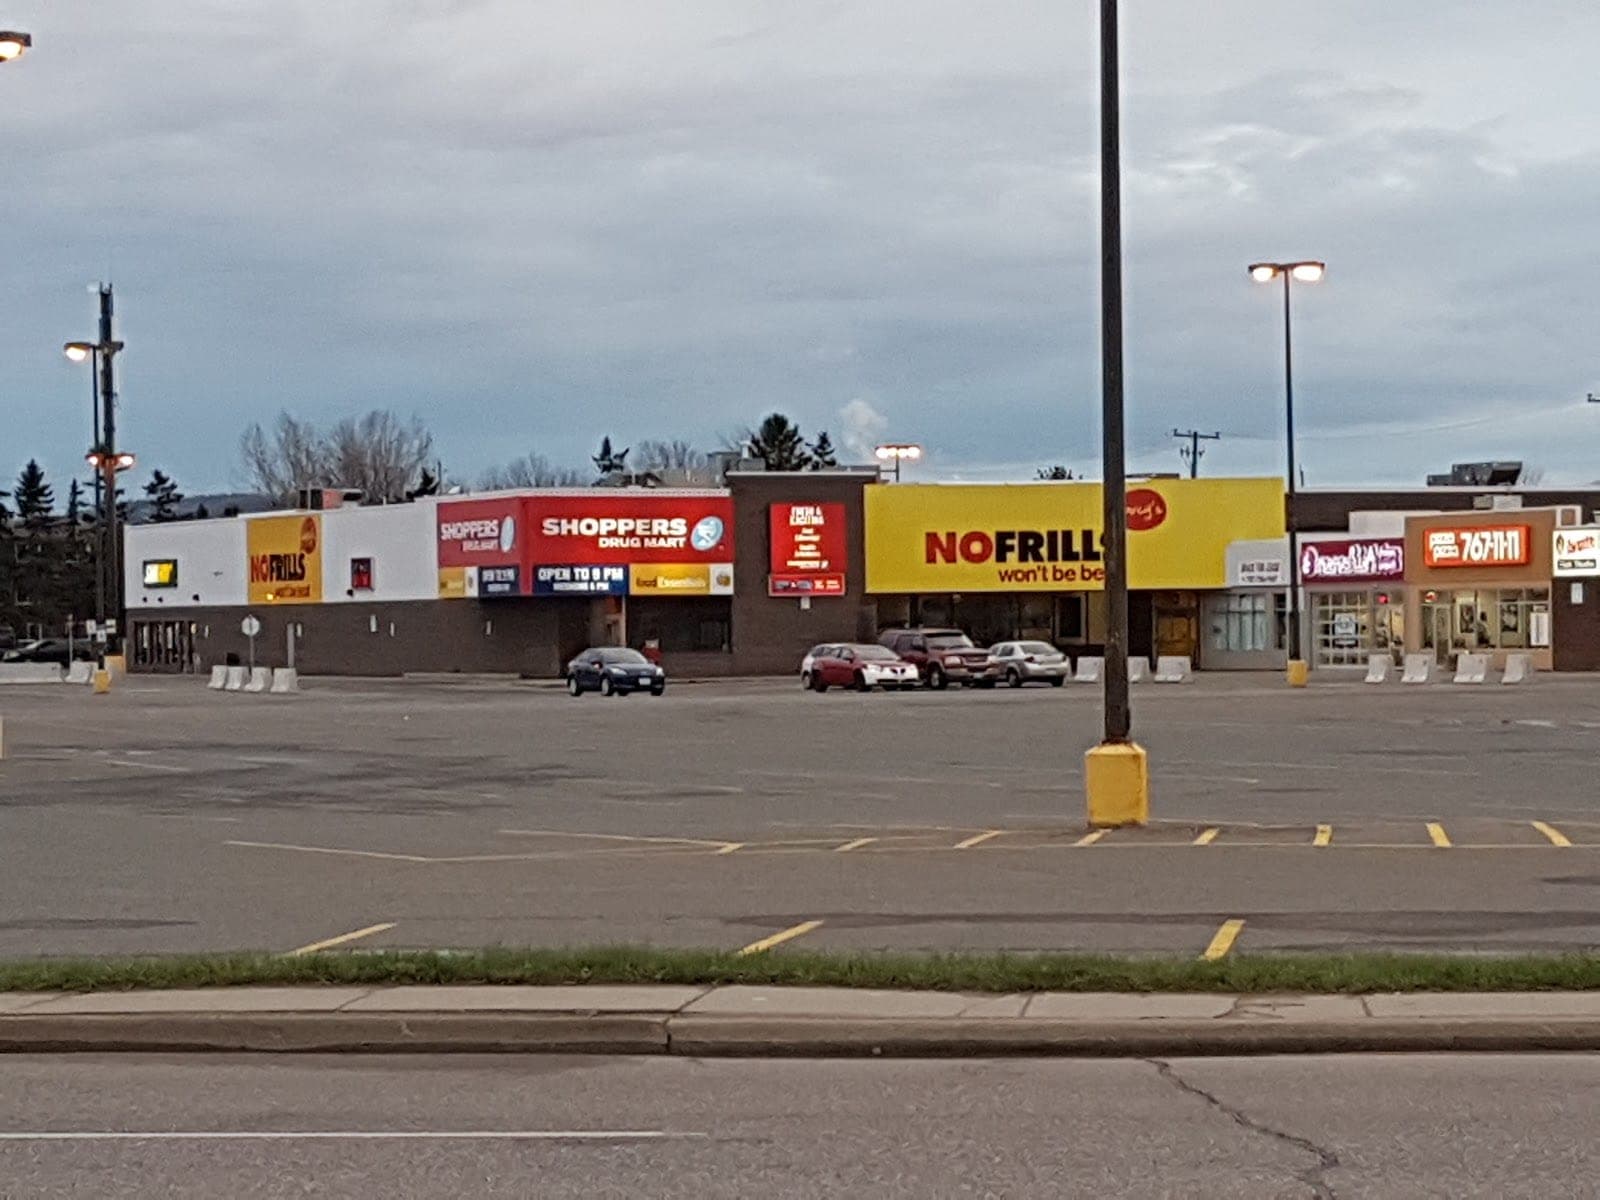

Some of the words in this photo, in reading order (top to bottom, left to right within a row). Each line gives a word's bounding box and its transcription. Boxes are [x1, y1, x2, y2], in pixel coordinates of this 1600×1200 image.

[441, 519, 499, 540] SHOPPERS
[542, 517, 688, 536] SHOPPERS
[598, 537, 642, 548] DRUG
[644, 537, 687, 548] MART
[925, 530, 1105, 564] NOFRILL
[538, 567, 571, 582] OPEN
[574, 567, 589, 581] TO
[603, 567, 624, 581] PM
[998, 565, 1048, 582] won't
[1053, 565, 1077, 581] be
[1081, 564, 1105, 581] be
